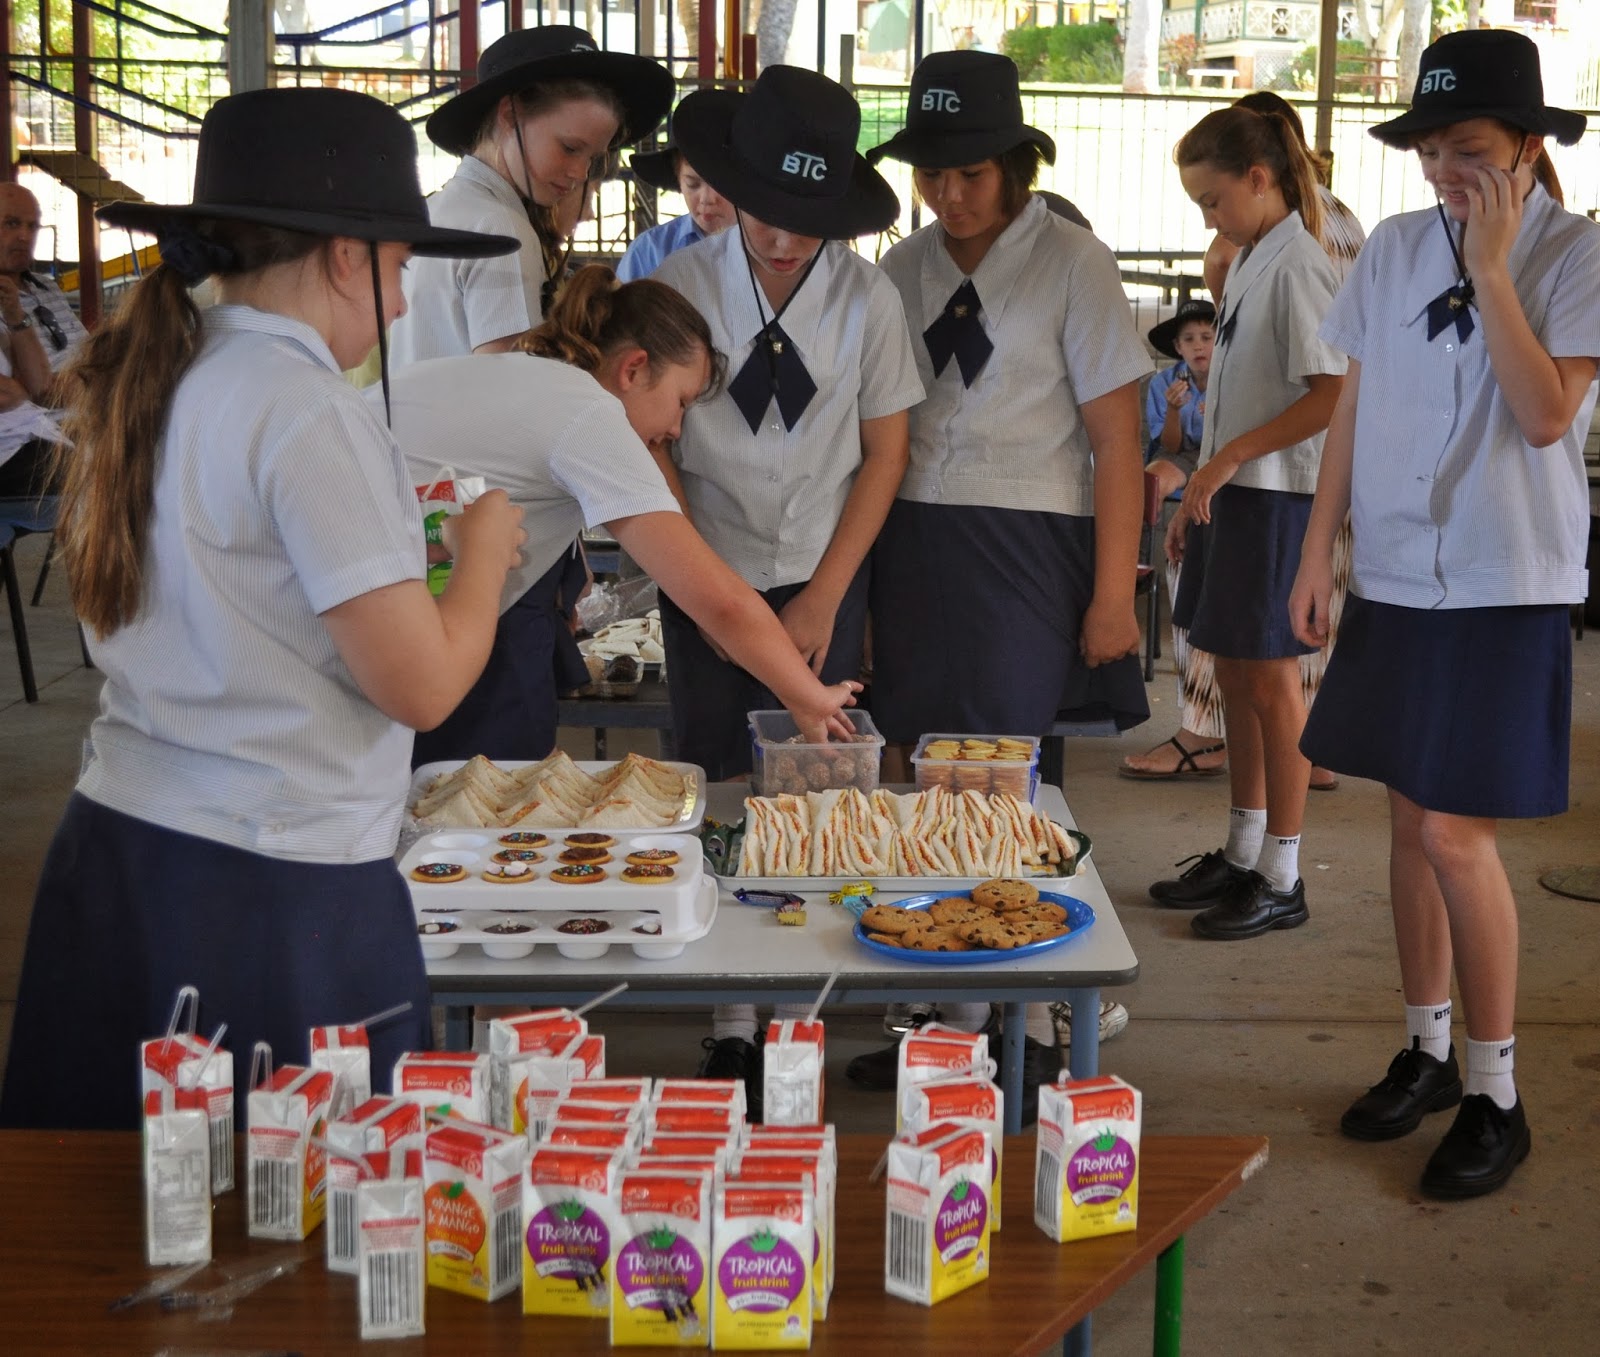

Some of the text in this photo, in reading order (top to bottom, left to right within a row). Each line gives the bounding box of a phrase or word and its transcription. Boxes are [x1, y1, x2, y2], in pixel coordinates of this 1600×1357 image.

[1421, 69, 1456, 94] BTC
[921, 89, 961, 112] BTC
[781, 151, 828, 181] BTC
[427, 528, 441, 541] APP
[1074, 1152, 1130, 1174] TROPICAL
[1078, 1171, 1125, 1186] fruit drink
[432, 1198, 474, 1219] ORANGE
[940, 1198, 983, 1230] TROPICAL
[439, 1213, 480, 1234] MANGO
[534, 1222, 603, 1243] TROPICAL
[944, 1217, 979, 1242] fruit drink
[541, 1243, 565, 1255] fruit
[624, 1252, 695, 1274] TROPICAL
[727, 1256, 796, 1277] TROPICAL
[631, 1273, 655, 1286] fruit
[733, 1276, 790, 1289] fruit drink
